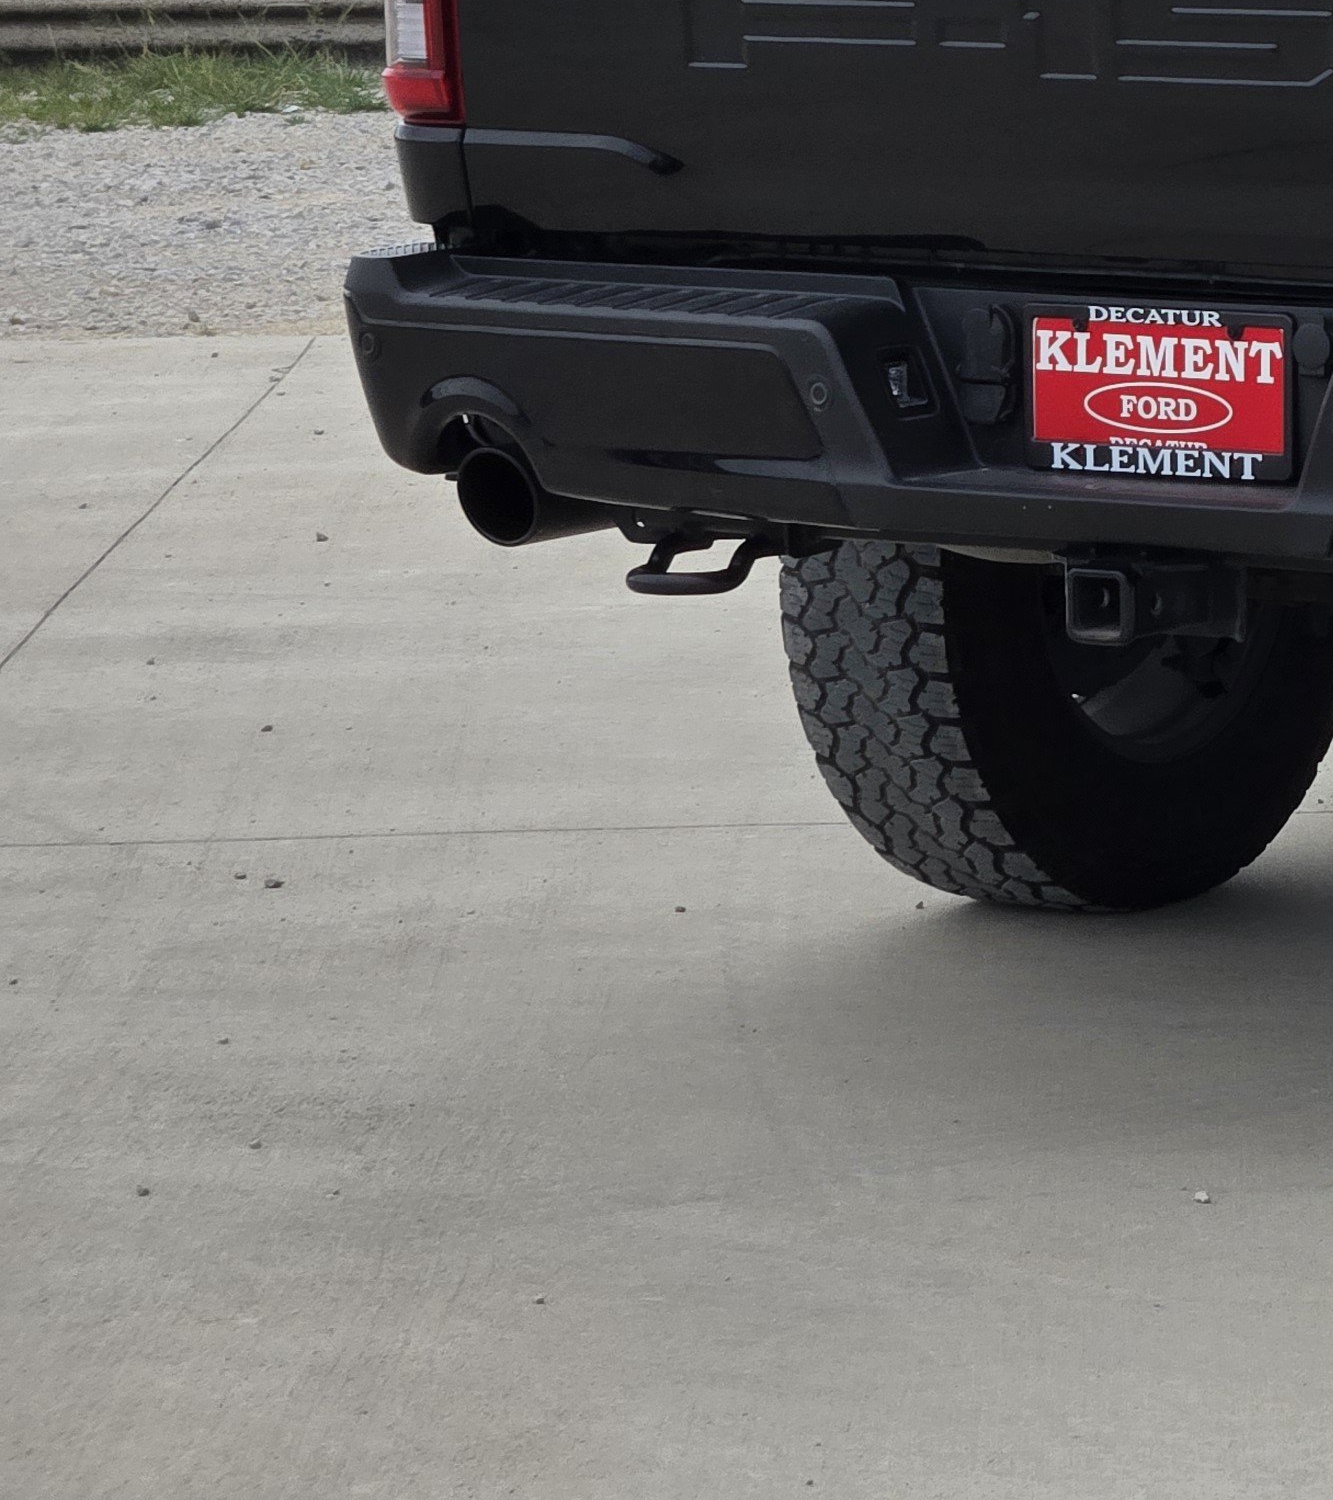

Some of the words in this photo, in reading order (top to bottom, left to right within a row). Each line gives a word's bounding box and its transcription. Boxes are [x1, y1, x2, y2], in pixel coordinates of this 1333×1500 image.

[1088, 305, 1222, 328] DECATUR
[1035, 329, 1283, 384] KLEMENT
[1119, 394, 1198, 422] FORD
[1051, 442, 1263, 480] KLEMENT
